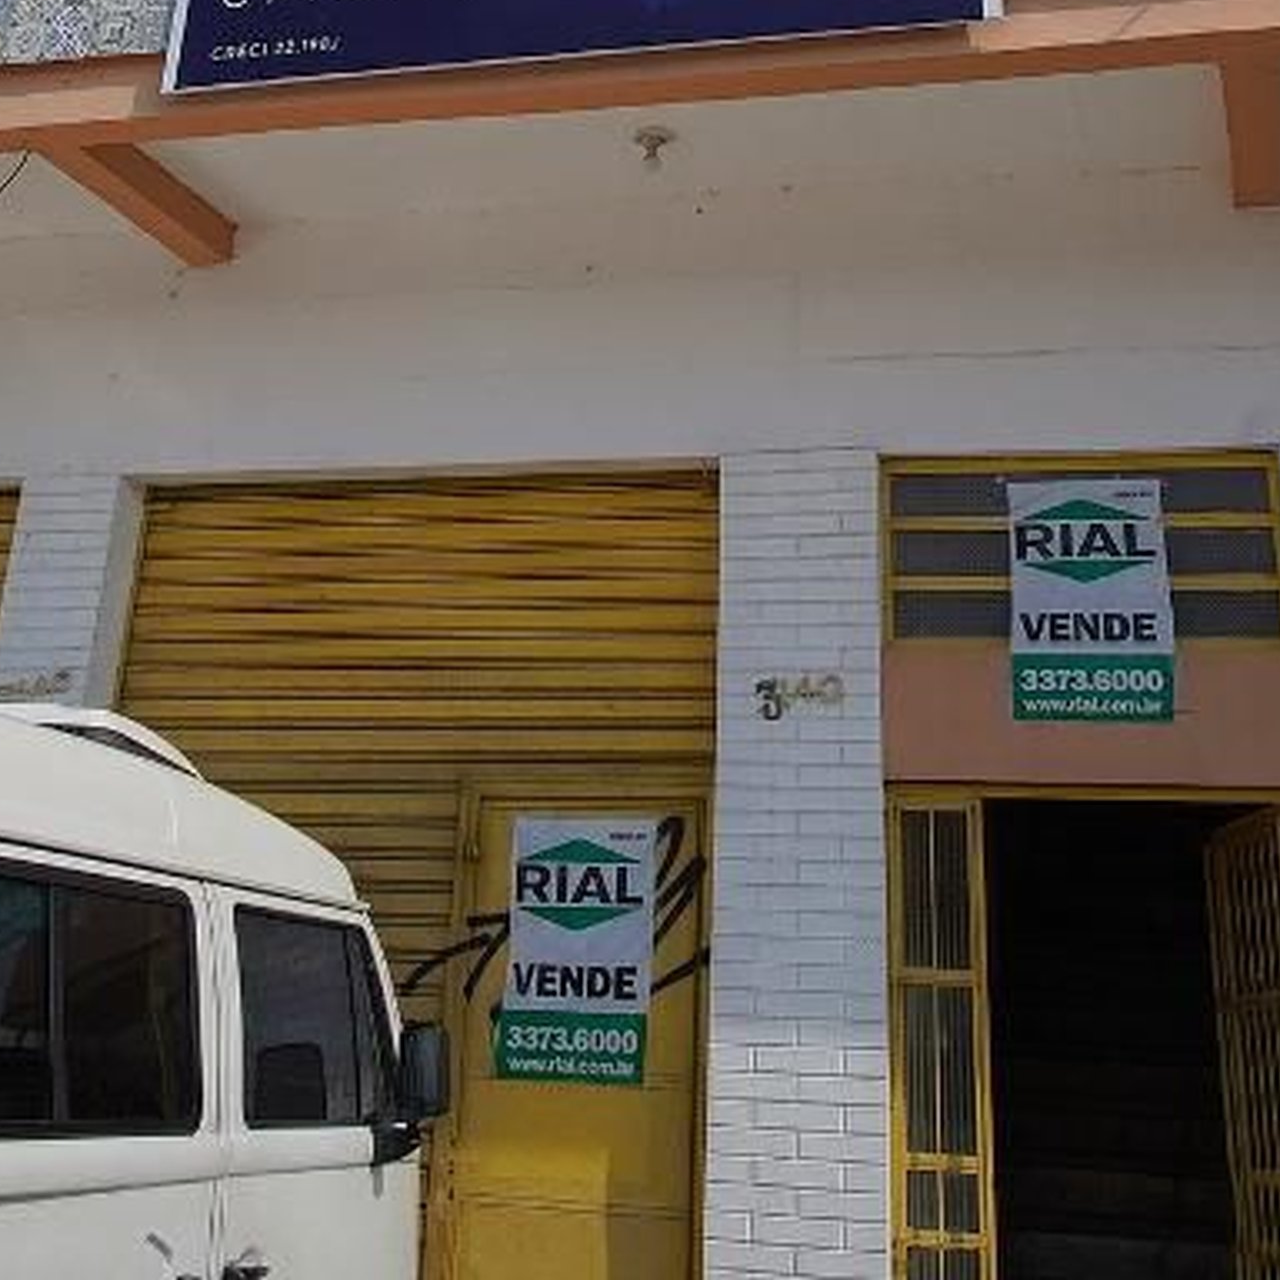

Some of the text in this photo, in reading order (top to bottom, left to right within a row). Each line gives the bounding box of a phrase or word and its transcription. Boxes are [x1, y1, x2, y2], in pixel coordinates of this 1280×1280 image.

[1015, 523, 1157, 560] RIAL
[1020, 612, 1158, 642] VENDE
[1020, 668, 1164, 692] 3373.6000
[516, 864, 644, 906] RIAL
[513, 963, 638, 1001] VENDE
[506, 1025, 639, 1055] 3373.6000
